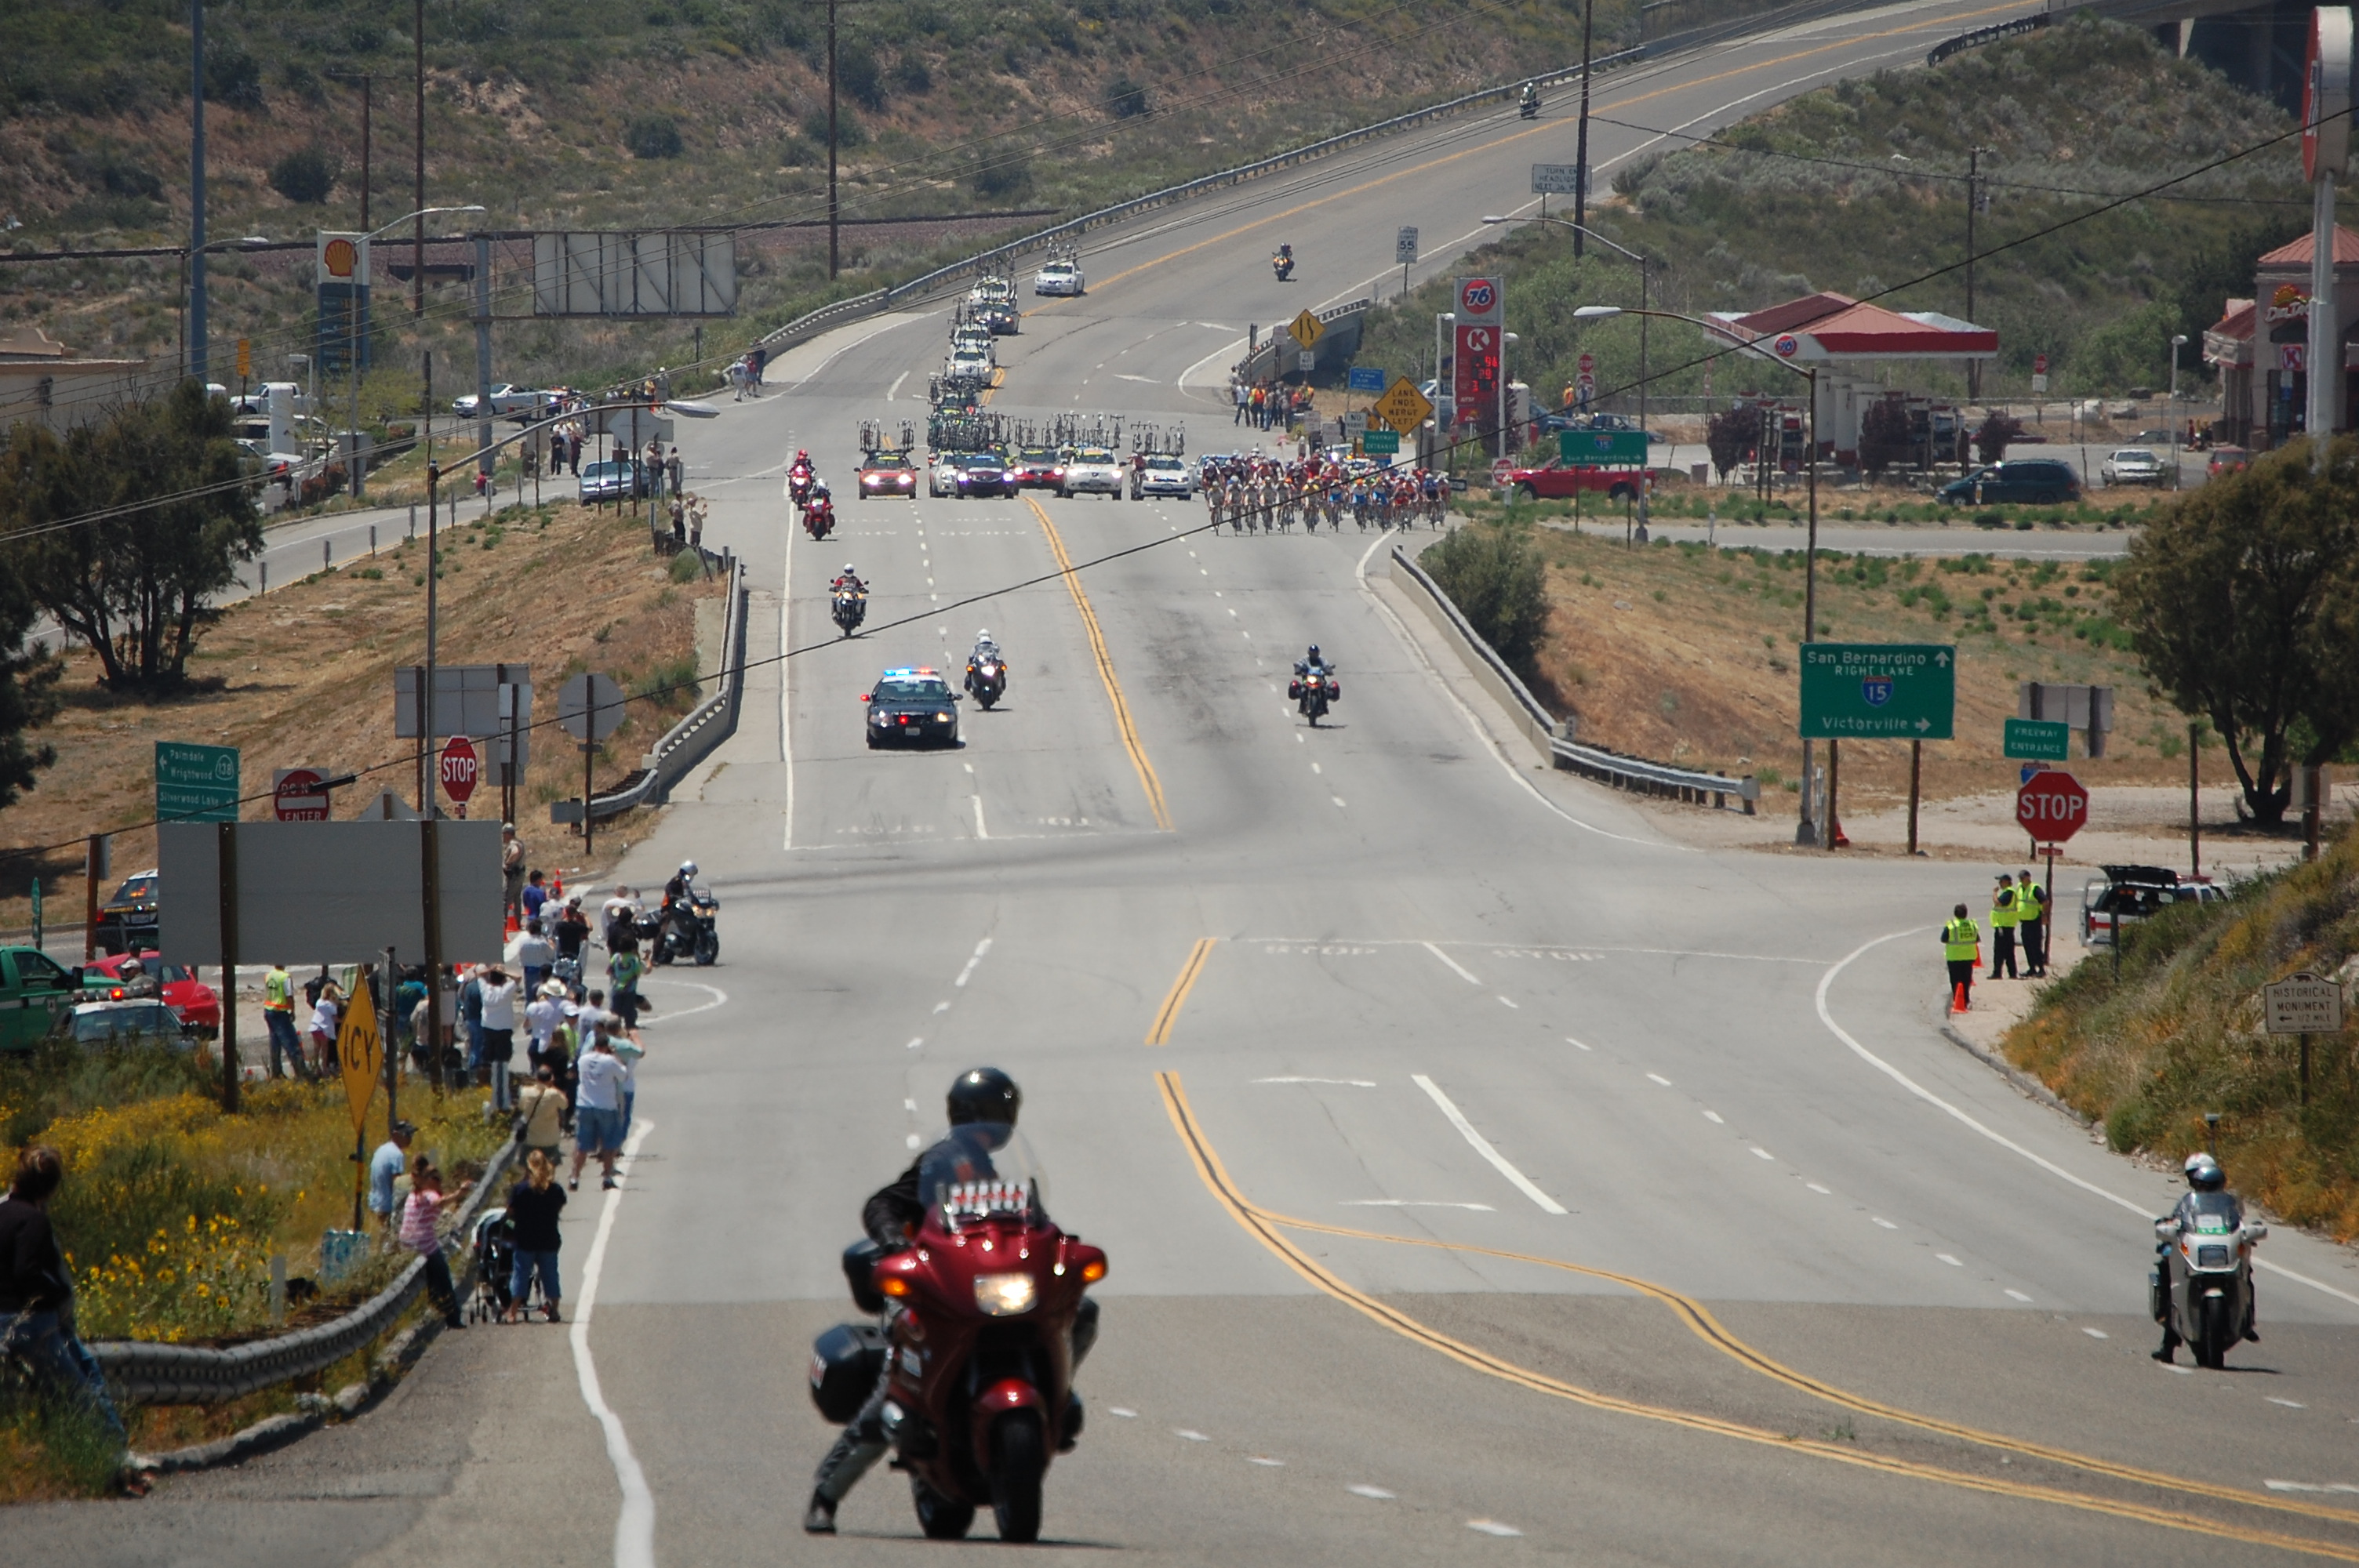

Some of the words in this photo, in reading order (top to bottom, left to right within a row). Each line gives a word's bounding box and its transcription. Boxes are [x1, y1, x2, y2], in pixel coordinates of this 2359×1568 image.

[1399, 241, 1415, 250] 55
[1467, 286, 1491, 306] 76
[1778, 339, 1794, 353] 76
[1808, 652, 1836, 663] San
[1842, 652, 1926, 665] Bernardino
[1835, 666, 1874, 676] RIGHT
[1881, 666, 1914, 676] LANE
[1869, 685, 1887, 701] 15
[1823, 717, 1908, 730] Victorville
[2015, 728, 2058, 738] FREEWAY
[2011, 742, 2061, 753] ENTRANCE
[169, 750, 204, 762] Palmdale
[170, 767, 213, 781] Wrightwood
[218, 763, 232, 775] 138
[443, 757, 475, 782] STOP
[160, 793, 198, 804] Silverwood
[201, 797, 219, 806] Lake
[2020, 794, 2084, 820] STOP
[285, 811, 321, 822] ENTER
[2274, 987, 2332, 997] HISTORICAL
[2277, 1002, 2330, 1011] MONUMENT
[344, 1025, 375, 1074] ICY
